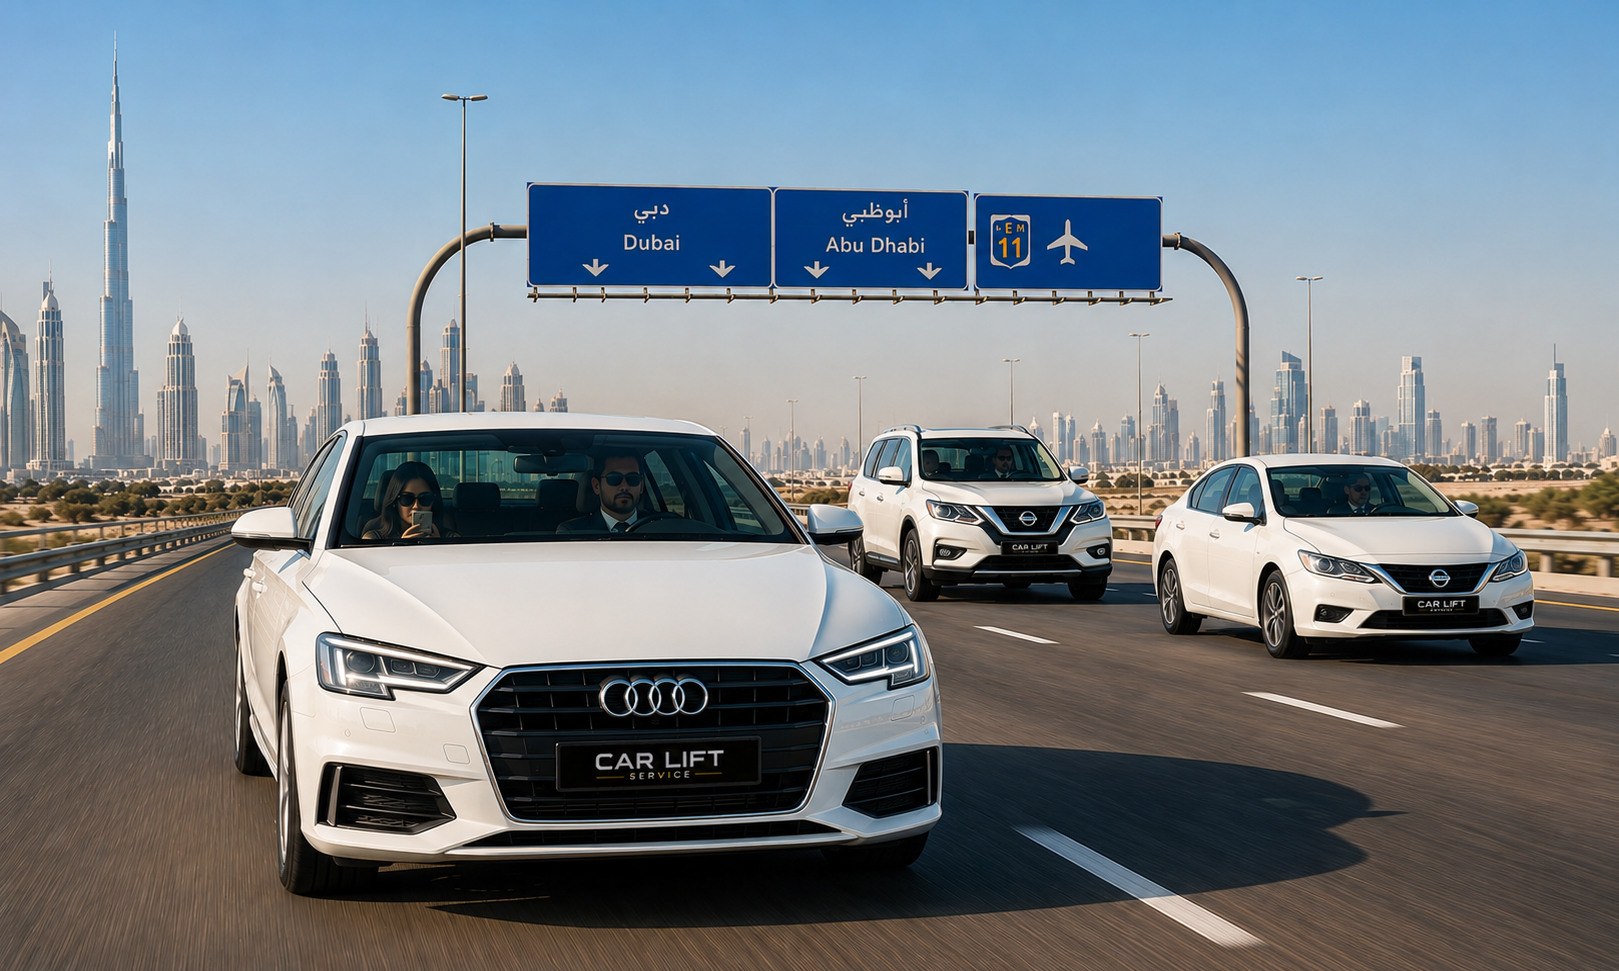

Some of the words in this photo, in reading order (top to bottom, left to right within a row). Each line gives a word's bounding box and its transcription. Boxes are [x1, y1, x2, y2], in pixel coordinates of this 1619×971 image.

[634, 203, 669, 224] دبي
[842, 198, 908, 227] أبوظبي
[624, 234, 680, 251] Dubai
[825, 236, 864, 253] Abu
[871, 237, 925, 254] Dhabi
[998, 237, 1021, 258] 11
[1417, 600, 1440, 608] CAR
[1443, 599, 1467, 608] LIFT
[595, 752, 654, 771] CAR
[665, 749, 725, 769] LIFT
[629, 770, 691, 781] SERVICE
